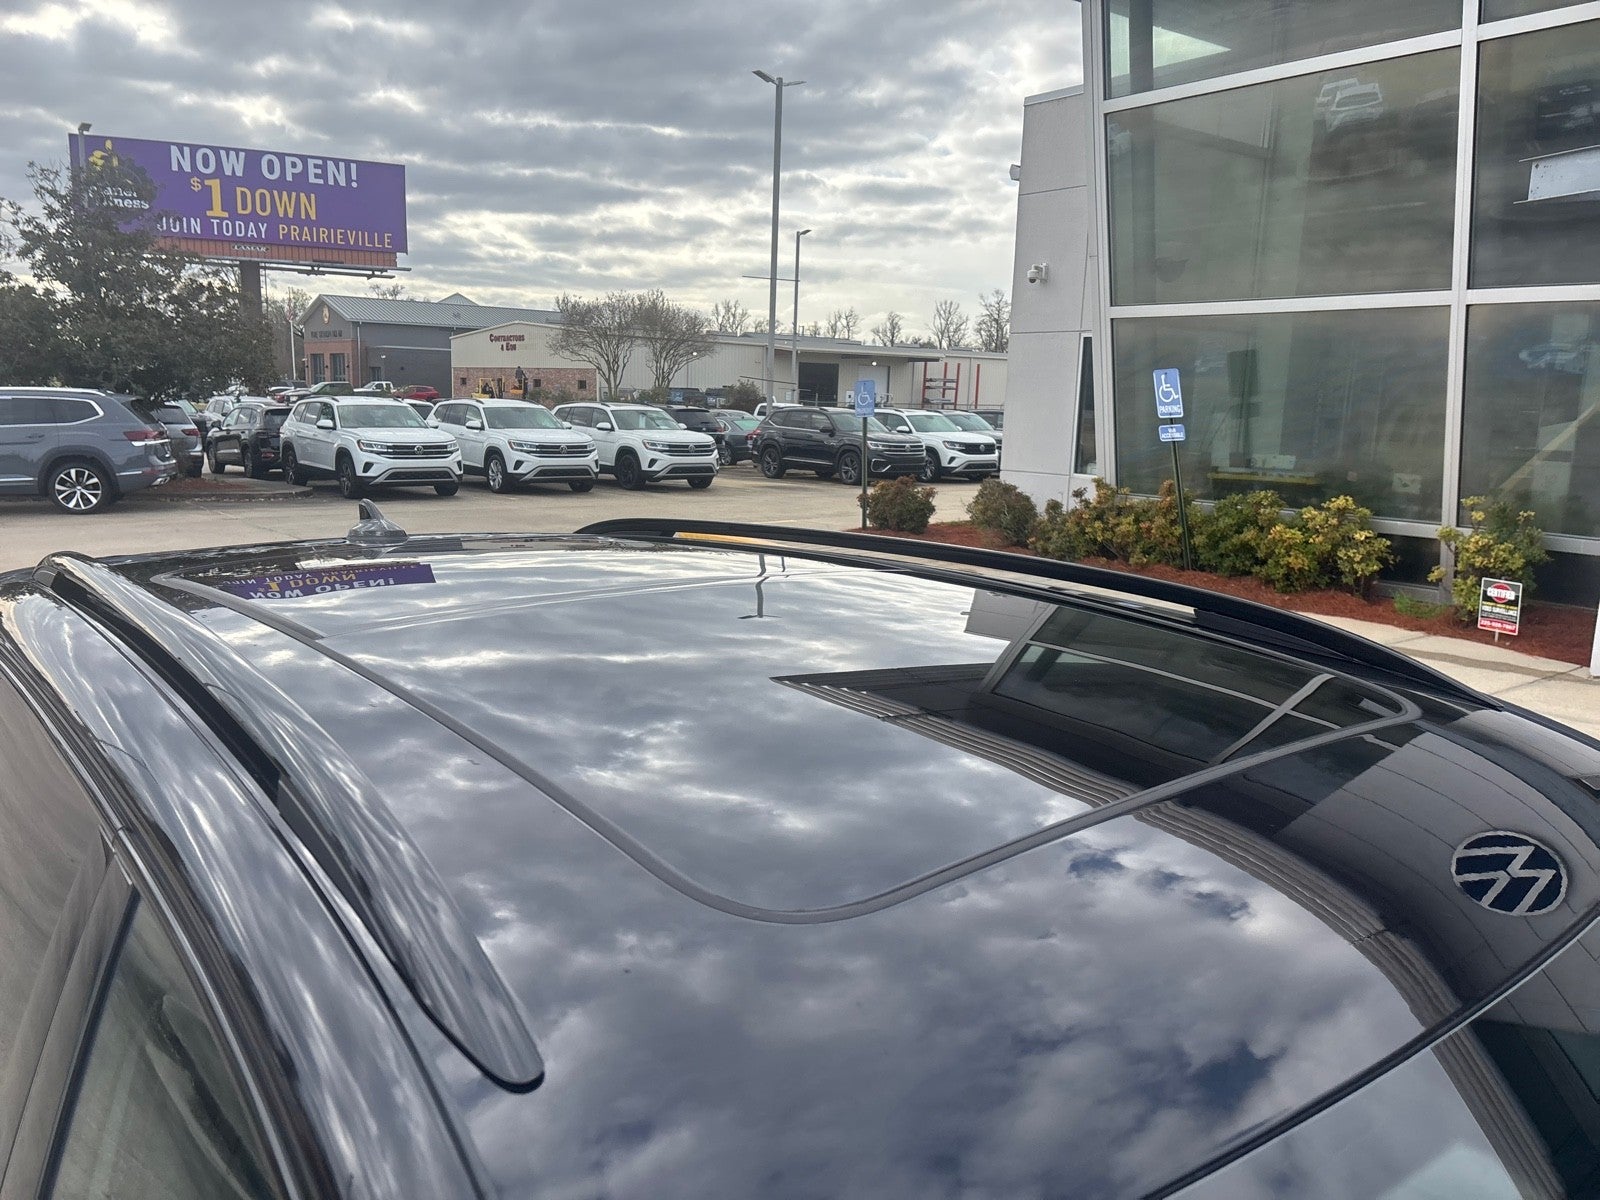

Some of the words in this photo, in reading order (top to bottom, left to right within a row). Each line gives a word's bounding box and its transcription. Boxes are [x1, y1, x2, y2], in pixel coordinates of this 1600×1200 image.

[170, 145, 246, 177] NOW
[260, 153, 358, 189] OPEN!
[235, 186, 317, 221] DOWN
[210, 218, 268, 239] TODAY
[279, 223, 393, 249] PRAIRIEVILLE
[1159, 405, 1181, 413] PARKING
